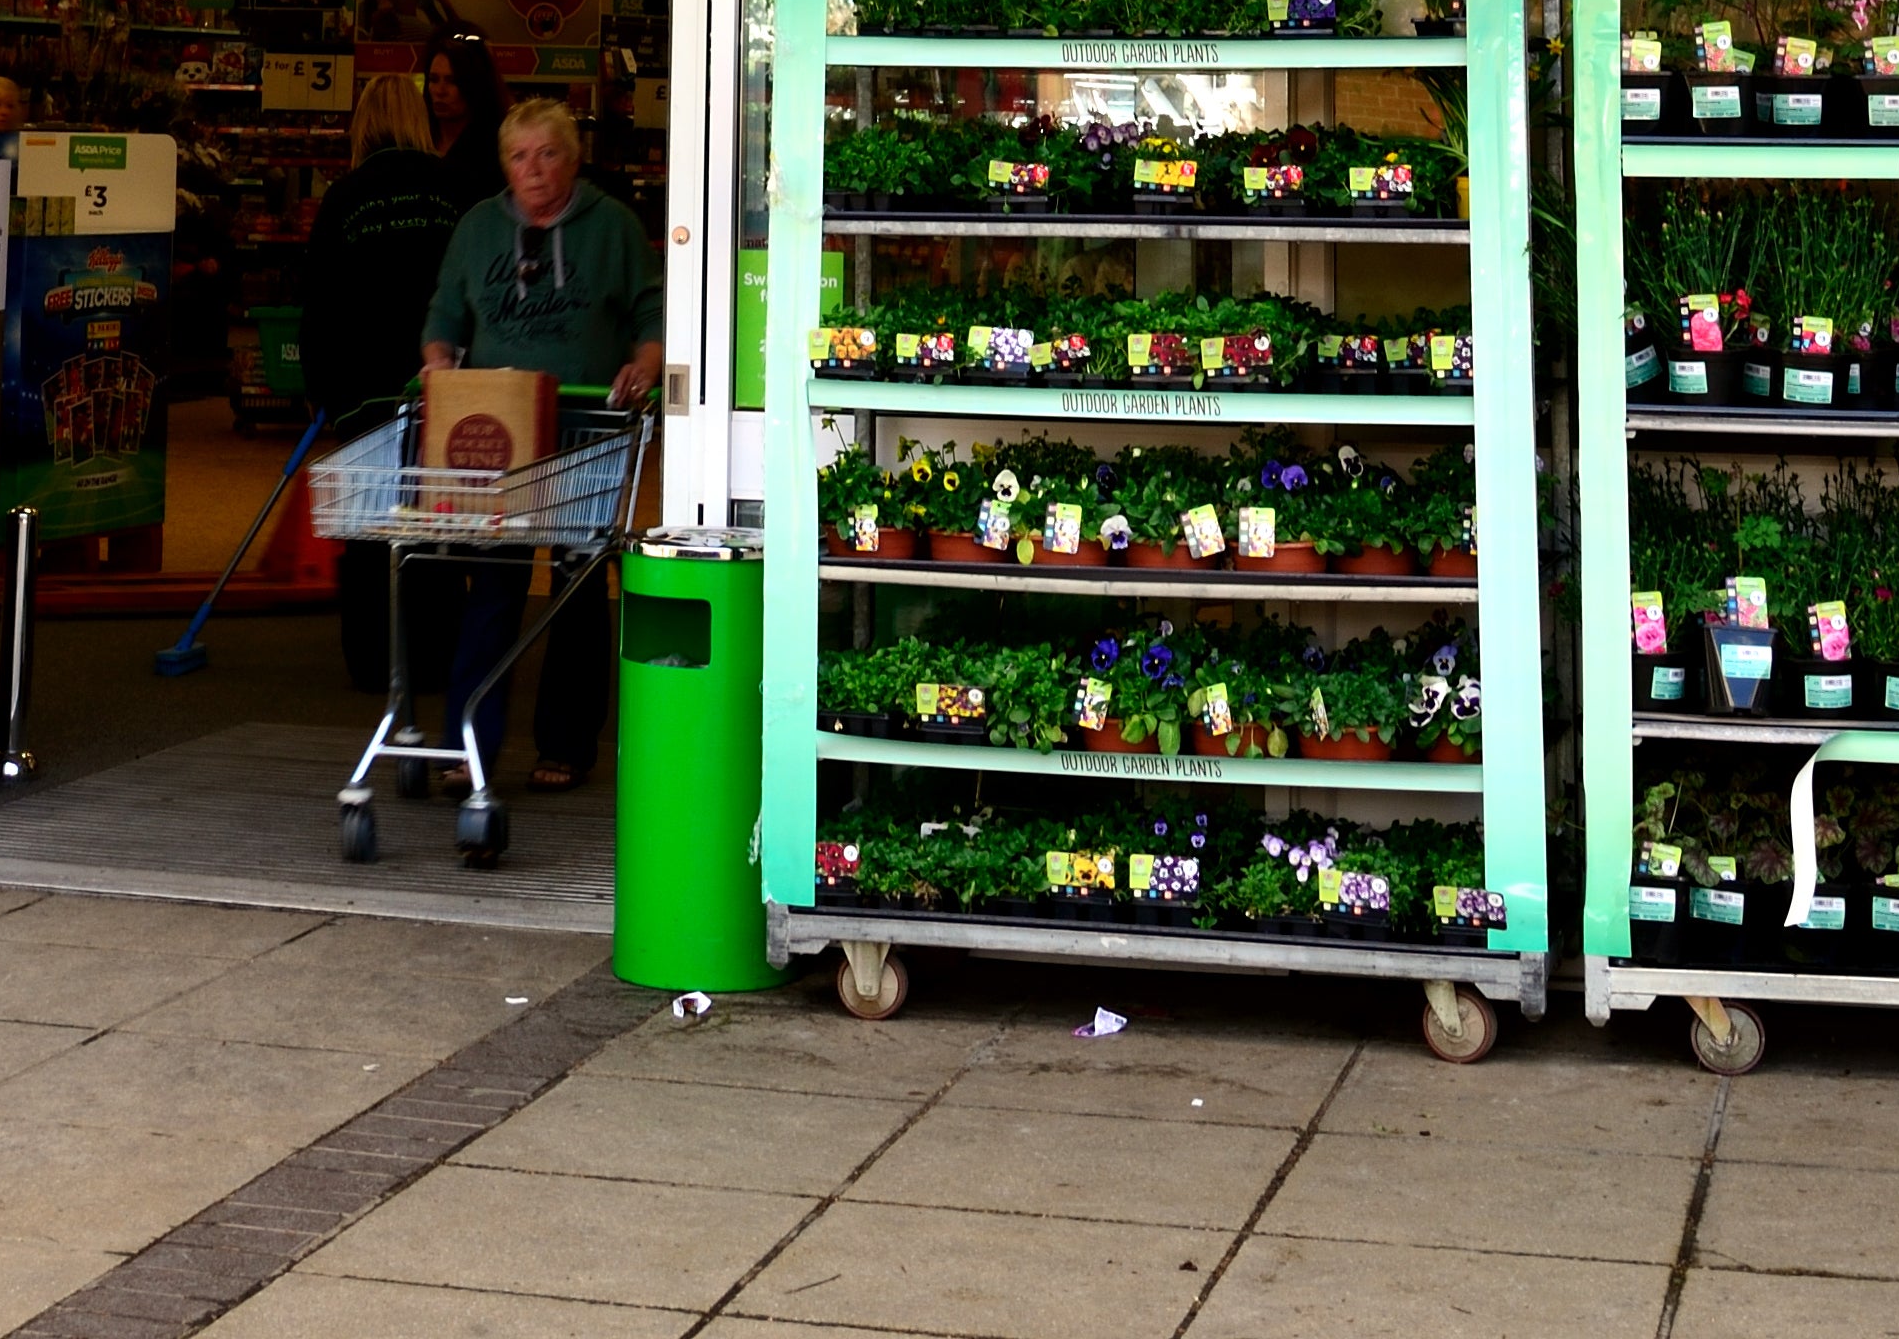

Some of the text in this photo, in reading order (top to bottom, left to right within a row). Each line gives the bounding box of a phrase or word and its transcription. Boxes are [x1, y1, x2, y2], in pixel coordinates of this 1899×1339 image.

[1062, 43, 1219, 63] OUTDOOR GARDEN PLANTS
[274, 61, 289, 70] for
[552, 58, 586, 70] ASDA
[74, 144, 122, 155] ASDA Price
[85, 185, 108, 208] £3
[47, 288, 72, 310] FREE
[74, 286, 132, 310] STICKERS
[1062, 392, 1221, 416] OUTDOOR GARDEN PLANTS
[1061, 753, 1222, 778] OUTDOOR GARDEN PLANTS
